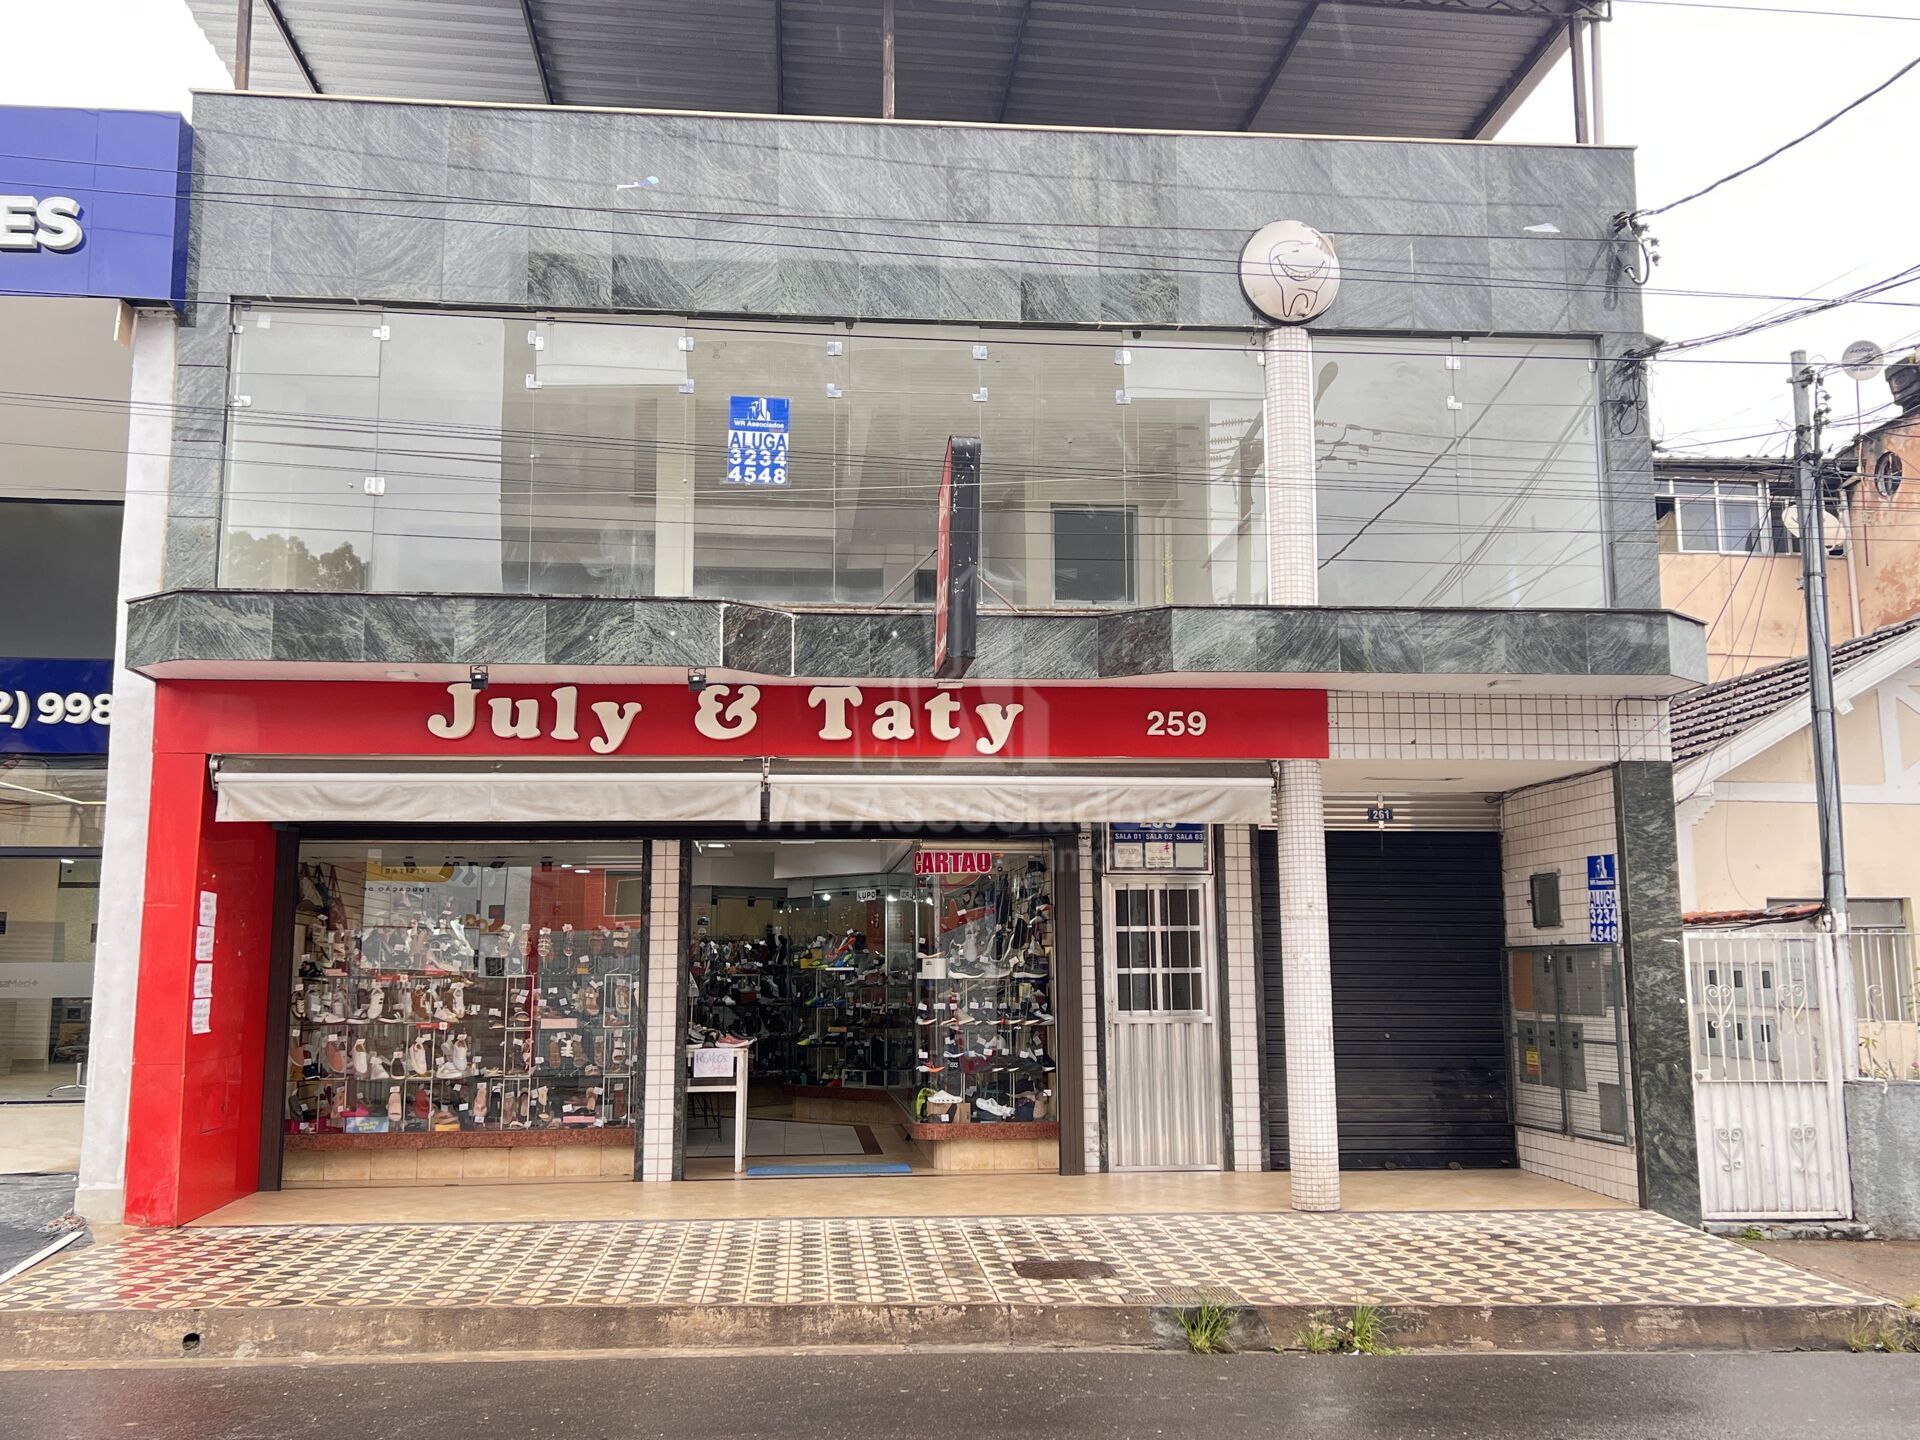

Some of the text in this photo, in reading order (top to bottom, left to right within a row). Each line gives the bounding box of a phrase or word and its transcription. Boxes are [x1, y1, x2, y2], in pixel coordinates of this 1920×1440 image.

[734, 419, 746, 427] WR
[730, 432, 787, 451] ALUGA
[729, 448, 787, 467] 3234
[728, 465, 786, 484] 4548
[427, 683, 1024, 754] July & Taty
[1146, 710, 1207, 737] 259
[1372, 810, 1390, 820] 261
[857, 891, 876, 900] LUPO
[1590, 891, 1617, 908] ALUGA
[1590, 908, 1617, 924] 3234
[1591, 925, 1618, 942] 4548
